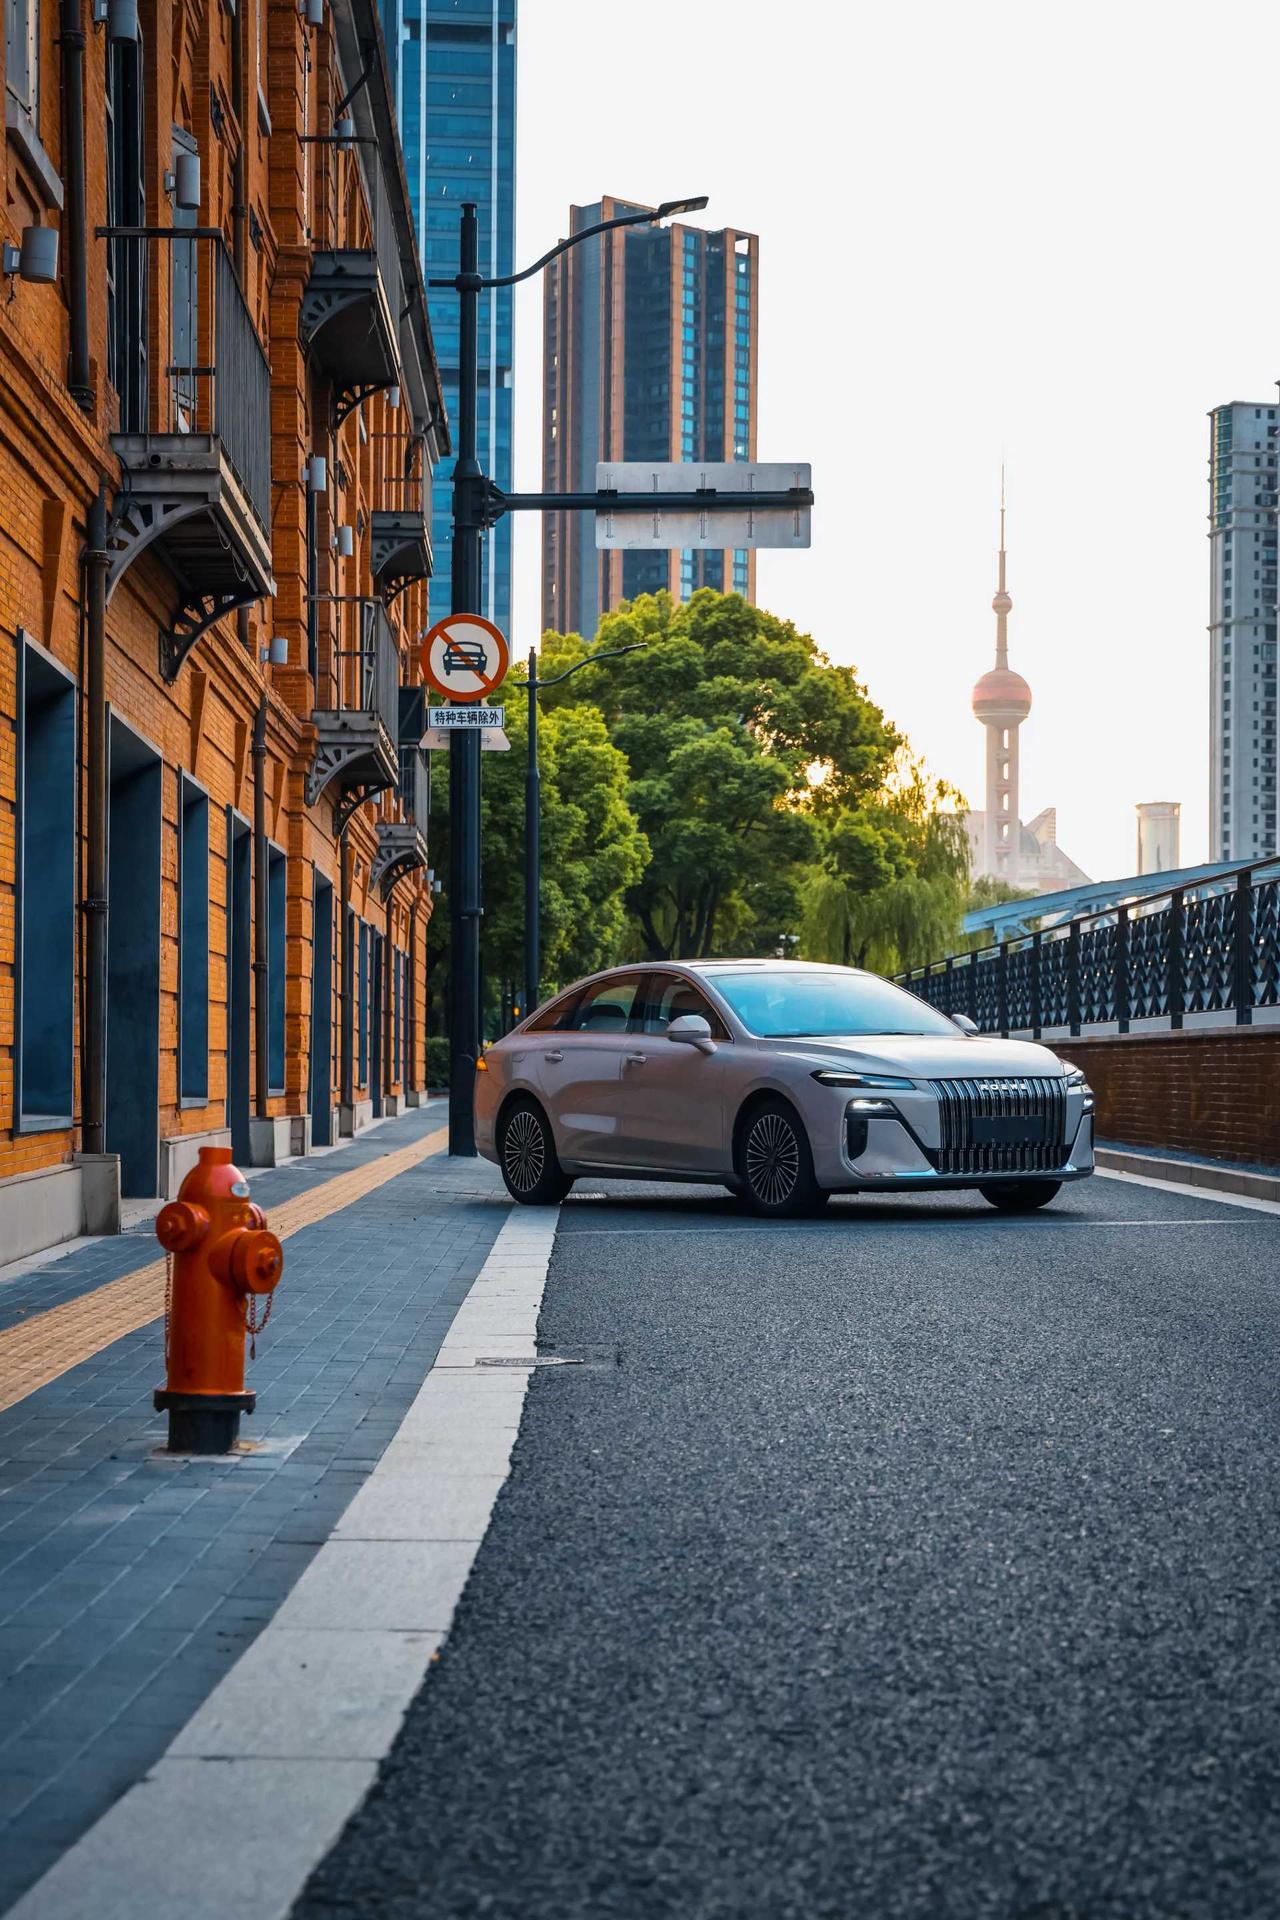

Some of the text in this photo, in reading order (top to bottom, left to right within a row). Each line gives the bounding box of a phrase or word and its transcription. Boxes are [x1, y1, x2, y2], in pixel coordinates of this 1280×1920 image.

[435, 711, 499, 724] 特种车辆除外
